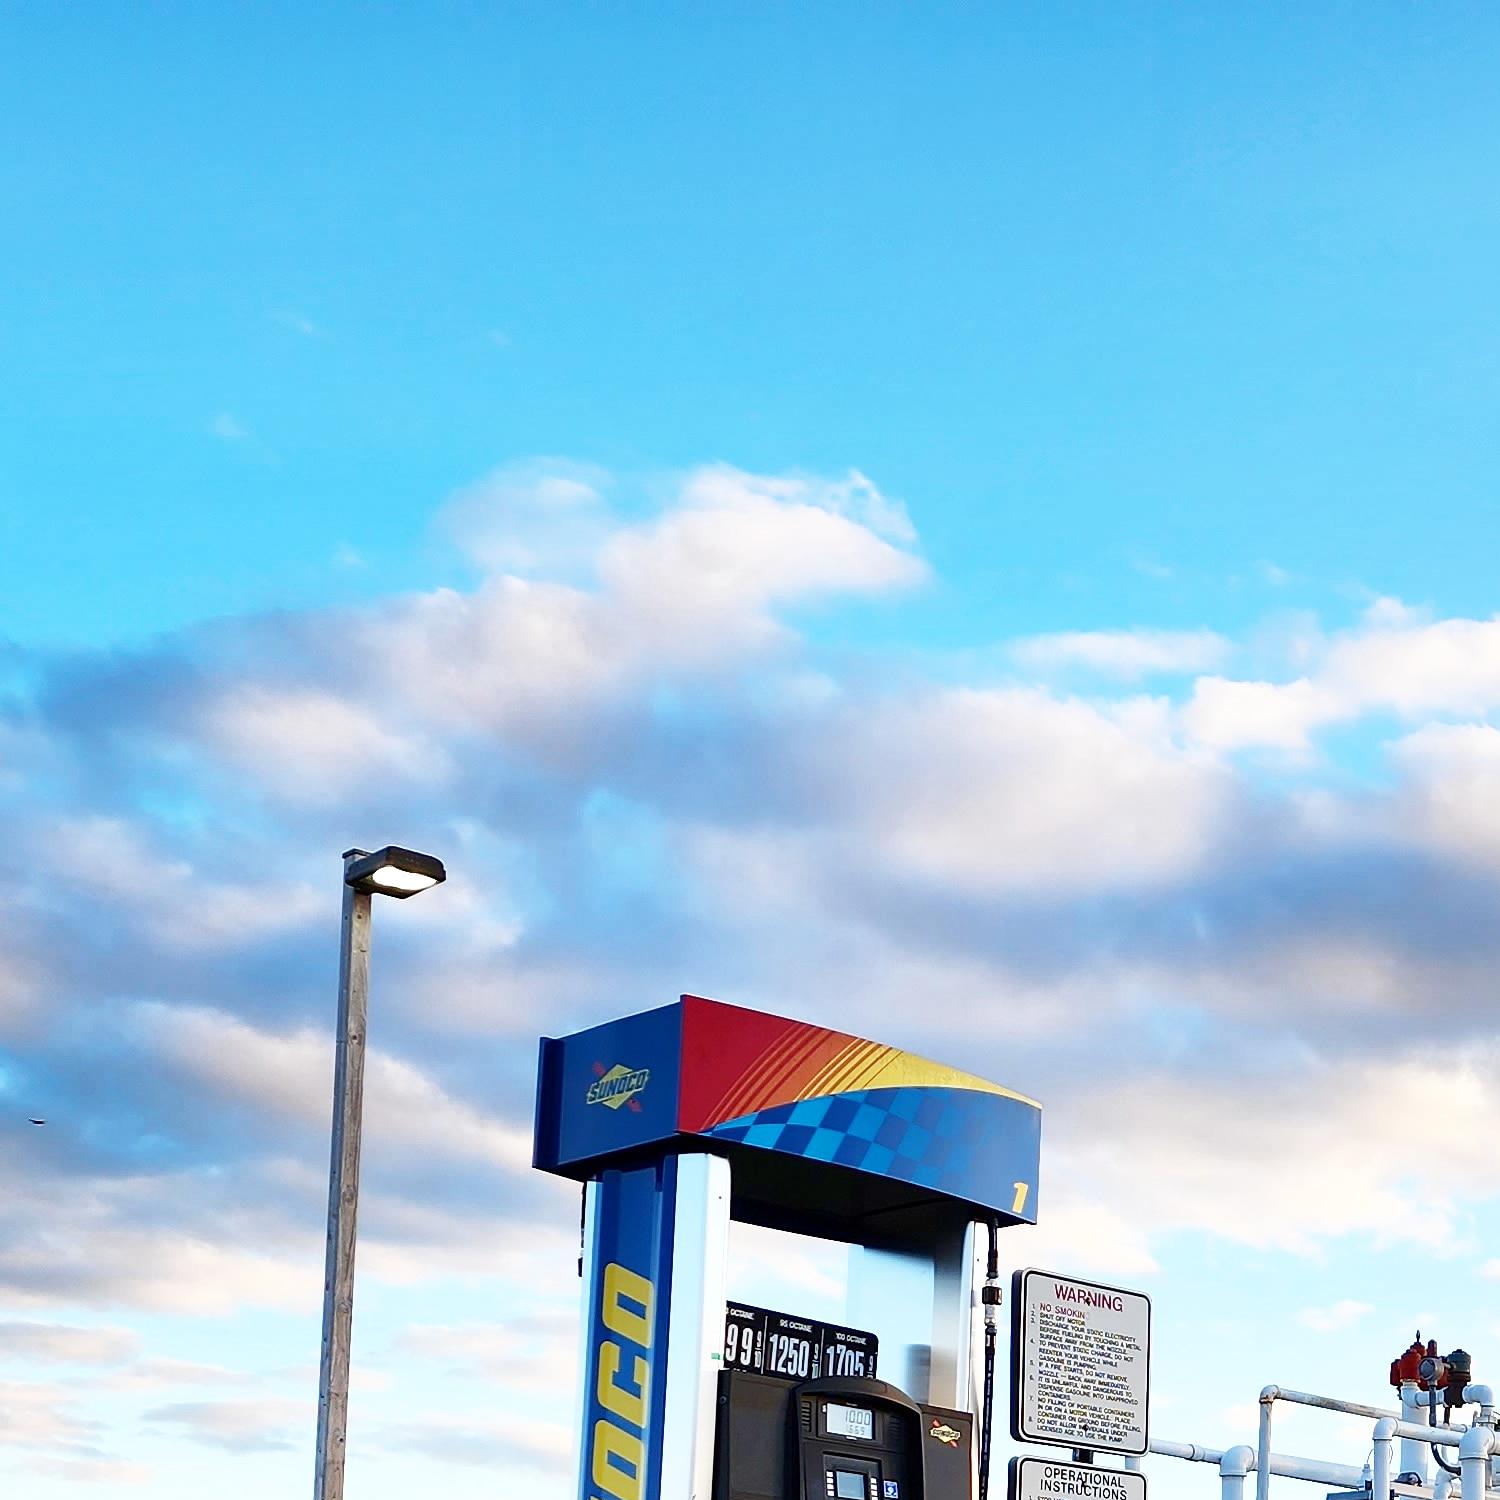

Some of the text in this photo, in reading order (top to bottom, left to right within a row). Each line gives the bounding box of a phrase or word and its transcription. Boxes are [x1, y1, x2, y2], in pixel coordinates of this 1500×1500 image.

[588, 1070, 649, 1102] SUNOCO
[1012, 1183, 1028, 1214] 1
[1054, 1284, 1123, 1312] WARNING
[730, 1309, 755, 1320] OCTANE
[1040, 1303, 1052, 1313] NO
[1040, 1312, 1054, 1320] SHUT
[780, 1319, 813, 1333] 95 OCTANE
[1040, 1319, 1136, 1343] DISCHARGE YOUR STATIC ELECTRICITY
[836, 1332, 867, 1345] 100 OCTANE
[1040, 1326, 1060, 1335] BEFORE
[1062, 1331, 1083, 1339] FUELING
[1093, 1337, 1119, 1346] TOUCHING
[1040, 1333, 1062, 1342] SURFACE
[1079, 1340, 1093, 1348] FROM
[1048, 1341, 1070, 1351] PREVENT
[1073, 1346, 1089, 1354] STATIC
[1039, 1348, 1118, 1367] REENTER YOUR VEHICLE WHILE
[1039, 1355, 1064, 1364] GASOLINE
[1039, 1370, 1058, 1378] NOZZLE
[1068, 1374, 1082, 1382] BACK
[1107, 1374, 1127, 1382] REMOVE
[1038, 1383, 1064, 1392] DISPENSE
[1065, 1388, 1090, 1397] GASOLINE
[1106, 1394, 1138, 1405] UNAPPROVED
[1052, 1379, 1079, 1388] UNLAWFUL
[1093, 1386, 1124, 1396] DANGEROUS
[1048, 1399, 1066, 1407] FILLING
[1077, 1403, 1102, 1412] PORTABLE
[1104, 1408, 1134, 1418] CONTAINERS
[1037, 1411, 1066, 1420] CONTAINER
[1078, 1417, 1099, 1425] GROUND
[1101, 1421, 1120, 1429] BEFORE
[1069, 1409, 1087, 1417] MOTOR
[1114, 1416, 1130, 1424] PLACE
[1037, 1425, 1063, 1434] LICENSED
[1059, 1421, 1077, 1429] ALLOW
[1111, 1429, 1127, 1437] UNDER
[1044, 1466, 1125, 1489] OPERATIONAL
